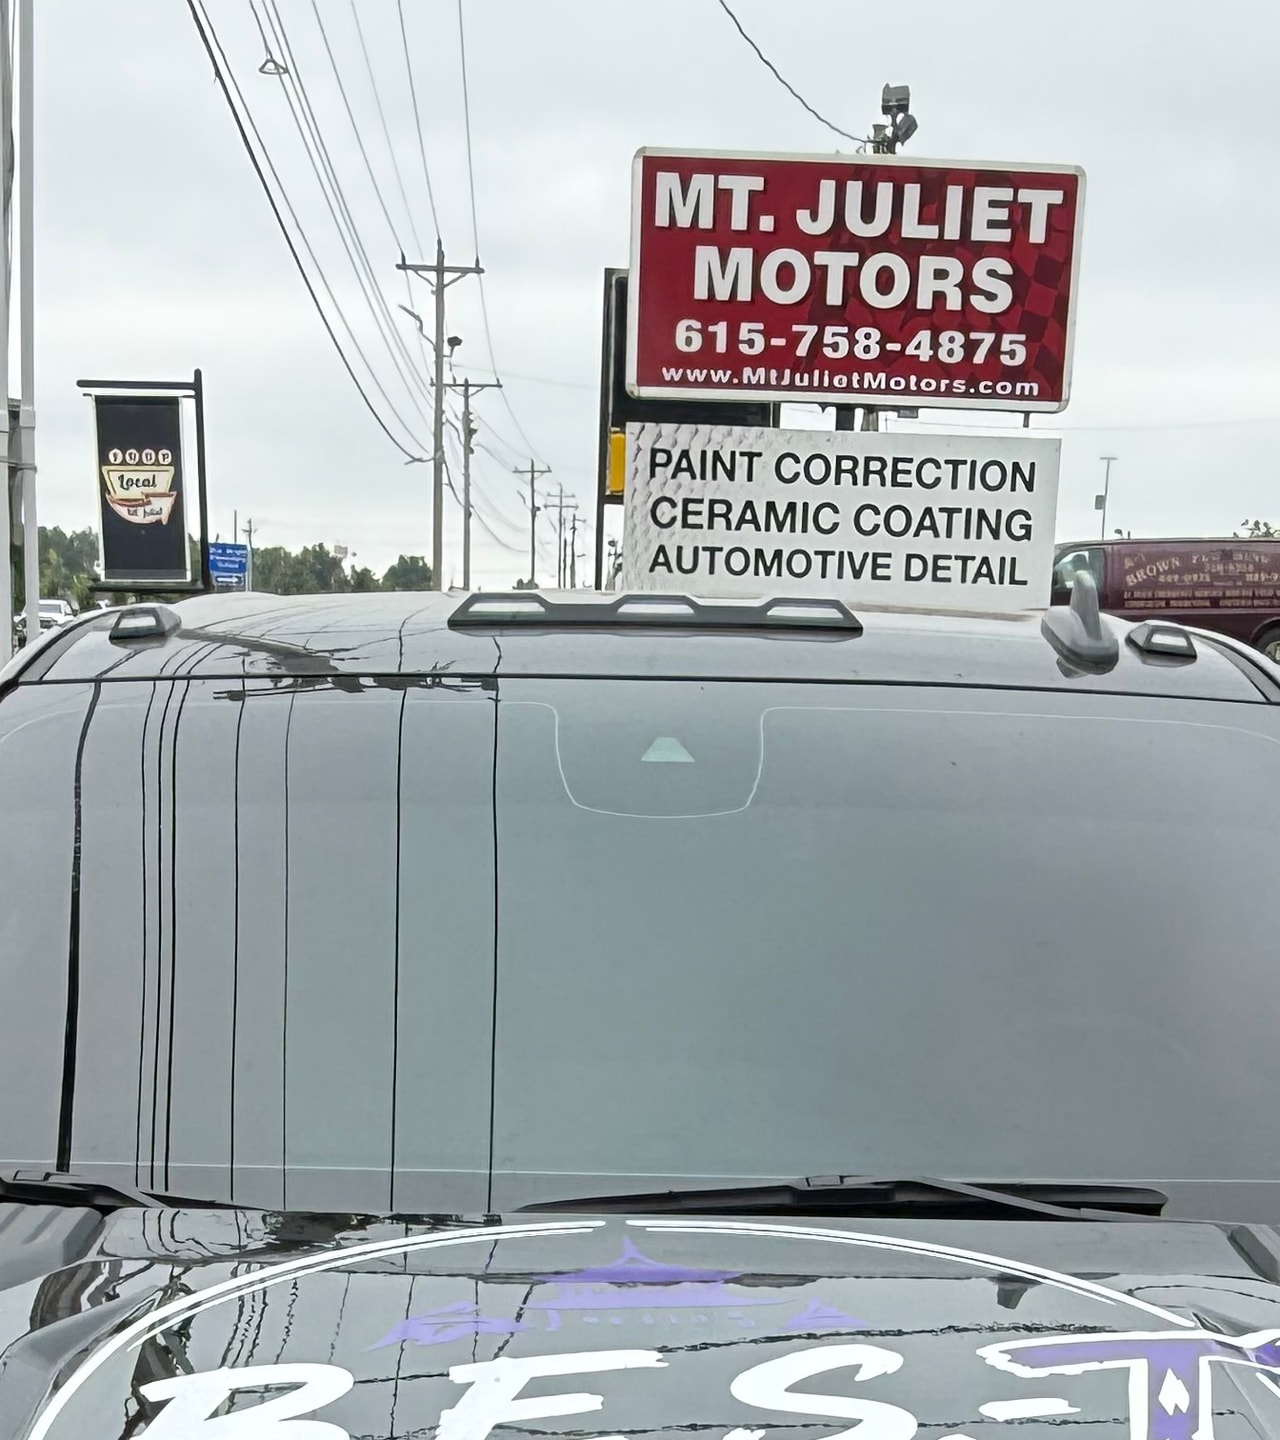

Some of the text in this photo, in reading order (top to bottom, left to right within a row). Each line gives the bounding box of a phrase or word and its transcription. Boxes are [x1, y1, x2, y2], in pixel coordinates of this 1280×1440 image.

[654, 171, 1065, 245] MT. JULIET
[693, 244, 1014, 315] MOTORS
[674, 318, 1028, 368] 615-758-4875
[118, 474, 157, 491] Local
[650, 447, 1037, 493] PAINT CORRECTION
[650, 495, 1033, 542] CERAMIC COATING
[649, 544, 1029, 586] AUTOMOTIVE DETAIL
